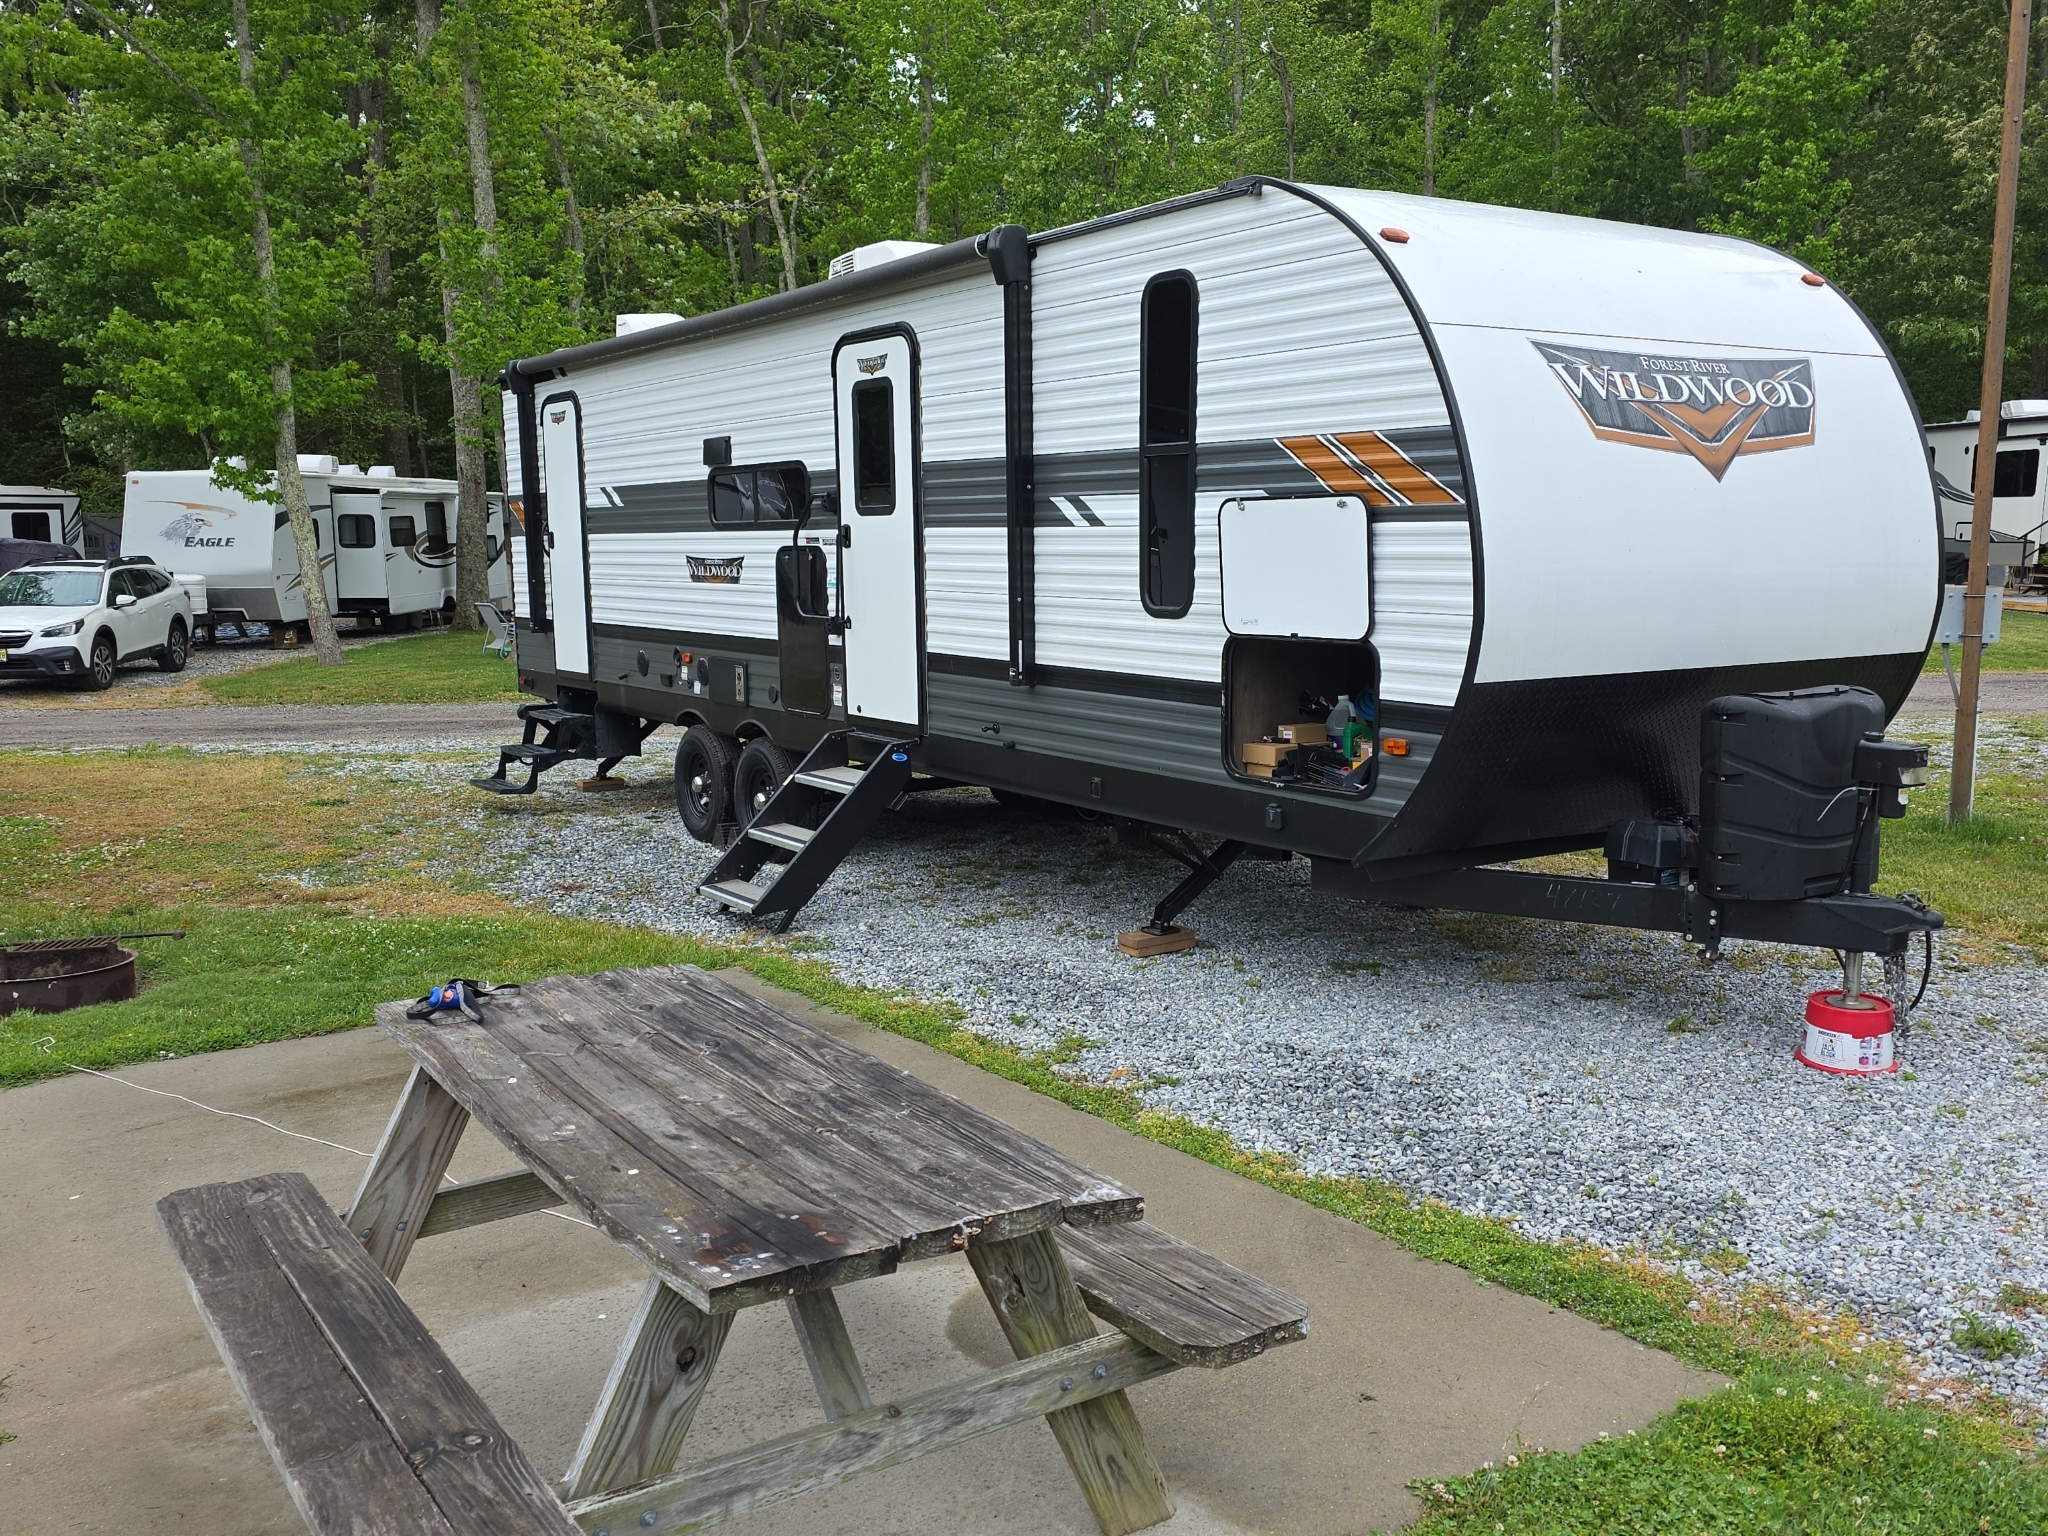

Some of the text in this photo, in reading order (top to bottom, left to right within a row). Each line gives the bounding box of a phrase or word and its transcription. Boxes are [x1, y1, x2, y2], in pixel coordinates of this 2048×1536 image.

[1639, 356, 1731, 375] FOREST RIVER
[1547, 361, 1815, 409] WILDWOOD
[184, 536, 235, 547] EAGLE
[687, 563, 742, 577] WILDWOOD
[1821, 1043, 1836, 1052] JACK
